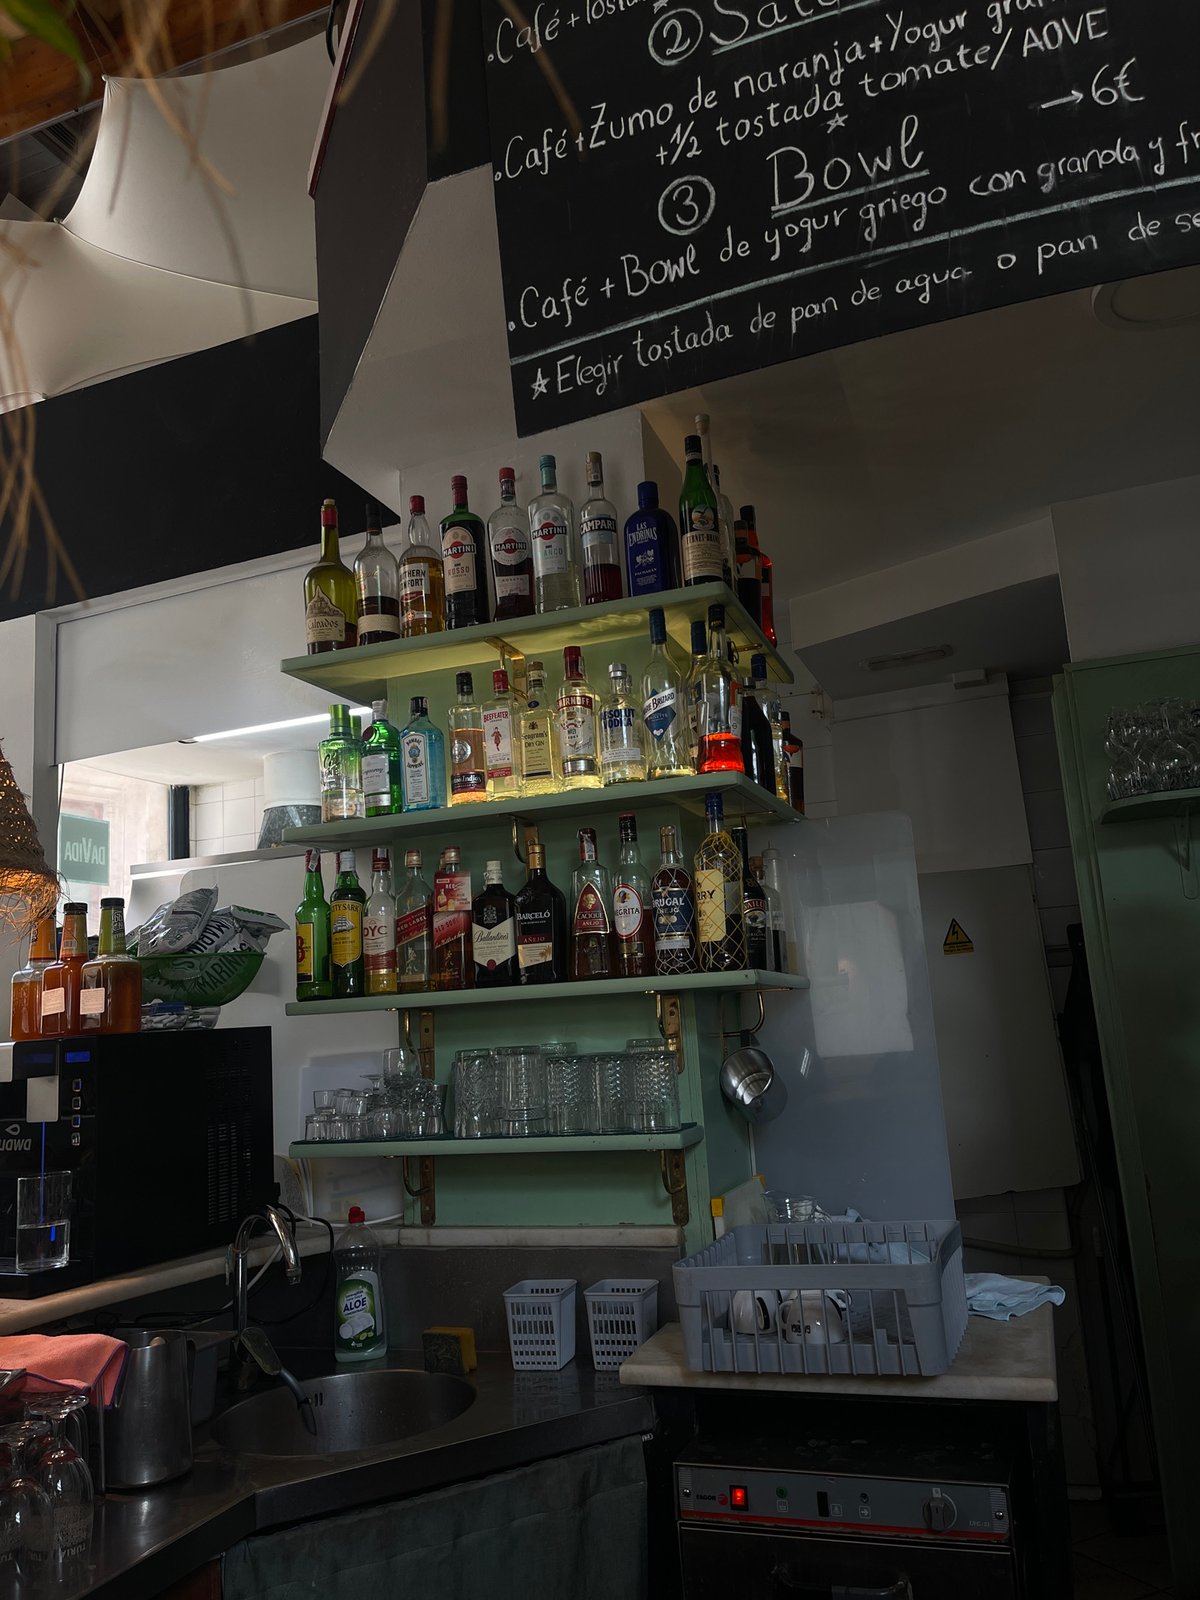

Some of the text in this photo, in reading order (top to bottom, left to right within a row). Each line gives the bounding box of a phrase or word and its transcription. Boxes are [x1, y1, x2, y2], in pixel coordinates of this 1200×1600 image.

[1091, 57, 1147, 107] 6€
[688, 75, 718, 115] de
[716, 84, 845, 147] tostada
[767, 114, 925, 211] Bowl
[620, 243, 701, 298] Bowl
[718, 225, 752, 264] de
[764, 206, 849, 262] yogur
[859, 186, 948, 242] griego
[968, 168, 1027, 200] con
[1036, 136, 1141, 195] granola
[1148, 136, 1166, 176] y
[555, 353, 625, 396] Elegir
[632, 310, 735, 368] tostada
[749, 302, 777, 335] de
[791, 295, 839, 334] pan
[850, 278, 882, 308] de
[894, 265, 973, 305] agua
[996, 252, 1017, 270] o
[1037, 233, 1099, 276] pan
[1127, 210, 1162, 242] de
[532, 526, 567, 540] MARTINI
[580, 519, 617, 535] CAMPARI
[636, 521, 648, 531] LAS
[628, 527, 658, 547] ENDRINAS
[443, 544, 475, 558] MARTINI
[495, 543, 527, 552] MARTINI
[447, 566, 470, 576] ROSSO
[483, 710, 509, 723] BEEFEATER
[342, 903, 360, 913] SARK
[409, 915, 427, 927] LABEL
[516, 909, 551, 922] BARCELÓ
[474, 930, 509, 943] Ballantine's
[523, 936, 545, 945] AÑEJO
[343, 1296, 367, 1313] ALOE
